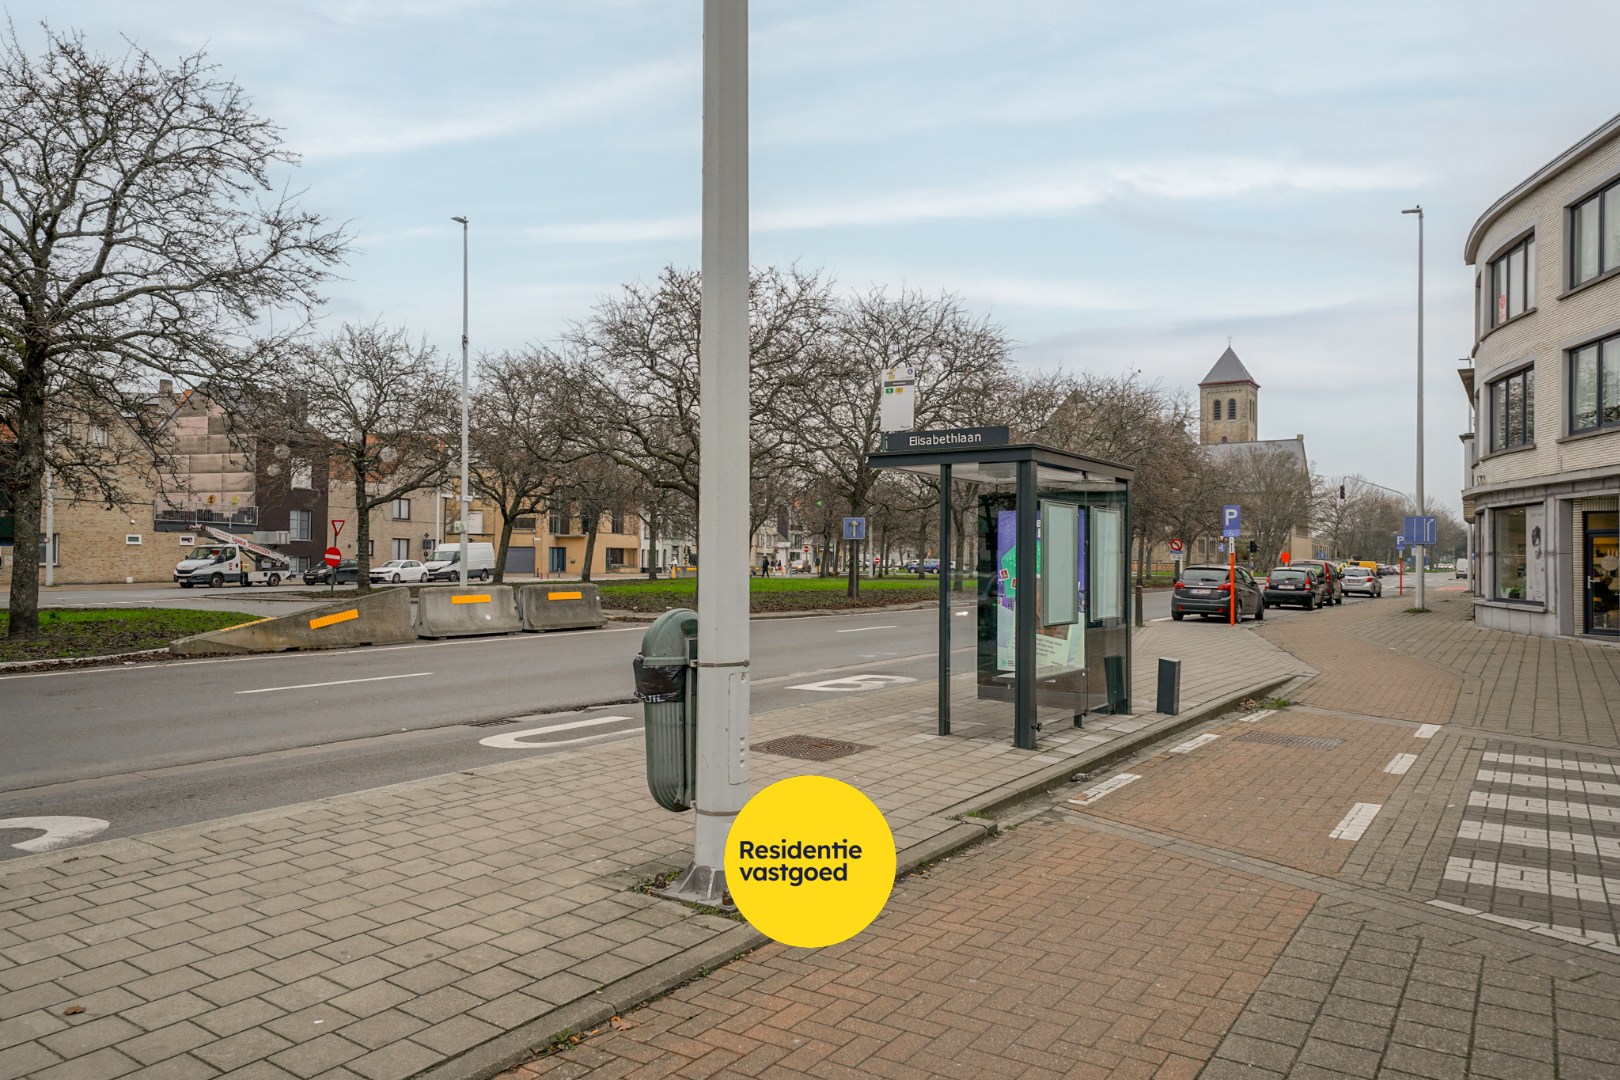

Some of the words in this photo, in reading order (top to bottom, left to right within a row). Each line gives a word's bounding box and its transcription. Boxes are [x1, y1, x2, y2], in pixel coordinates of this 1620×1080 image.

[909, 433, 982, 446] Elisabethlaan
[1225, 508, 1238, 526] P
[1396, 536, 1404, 545] P
